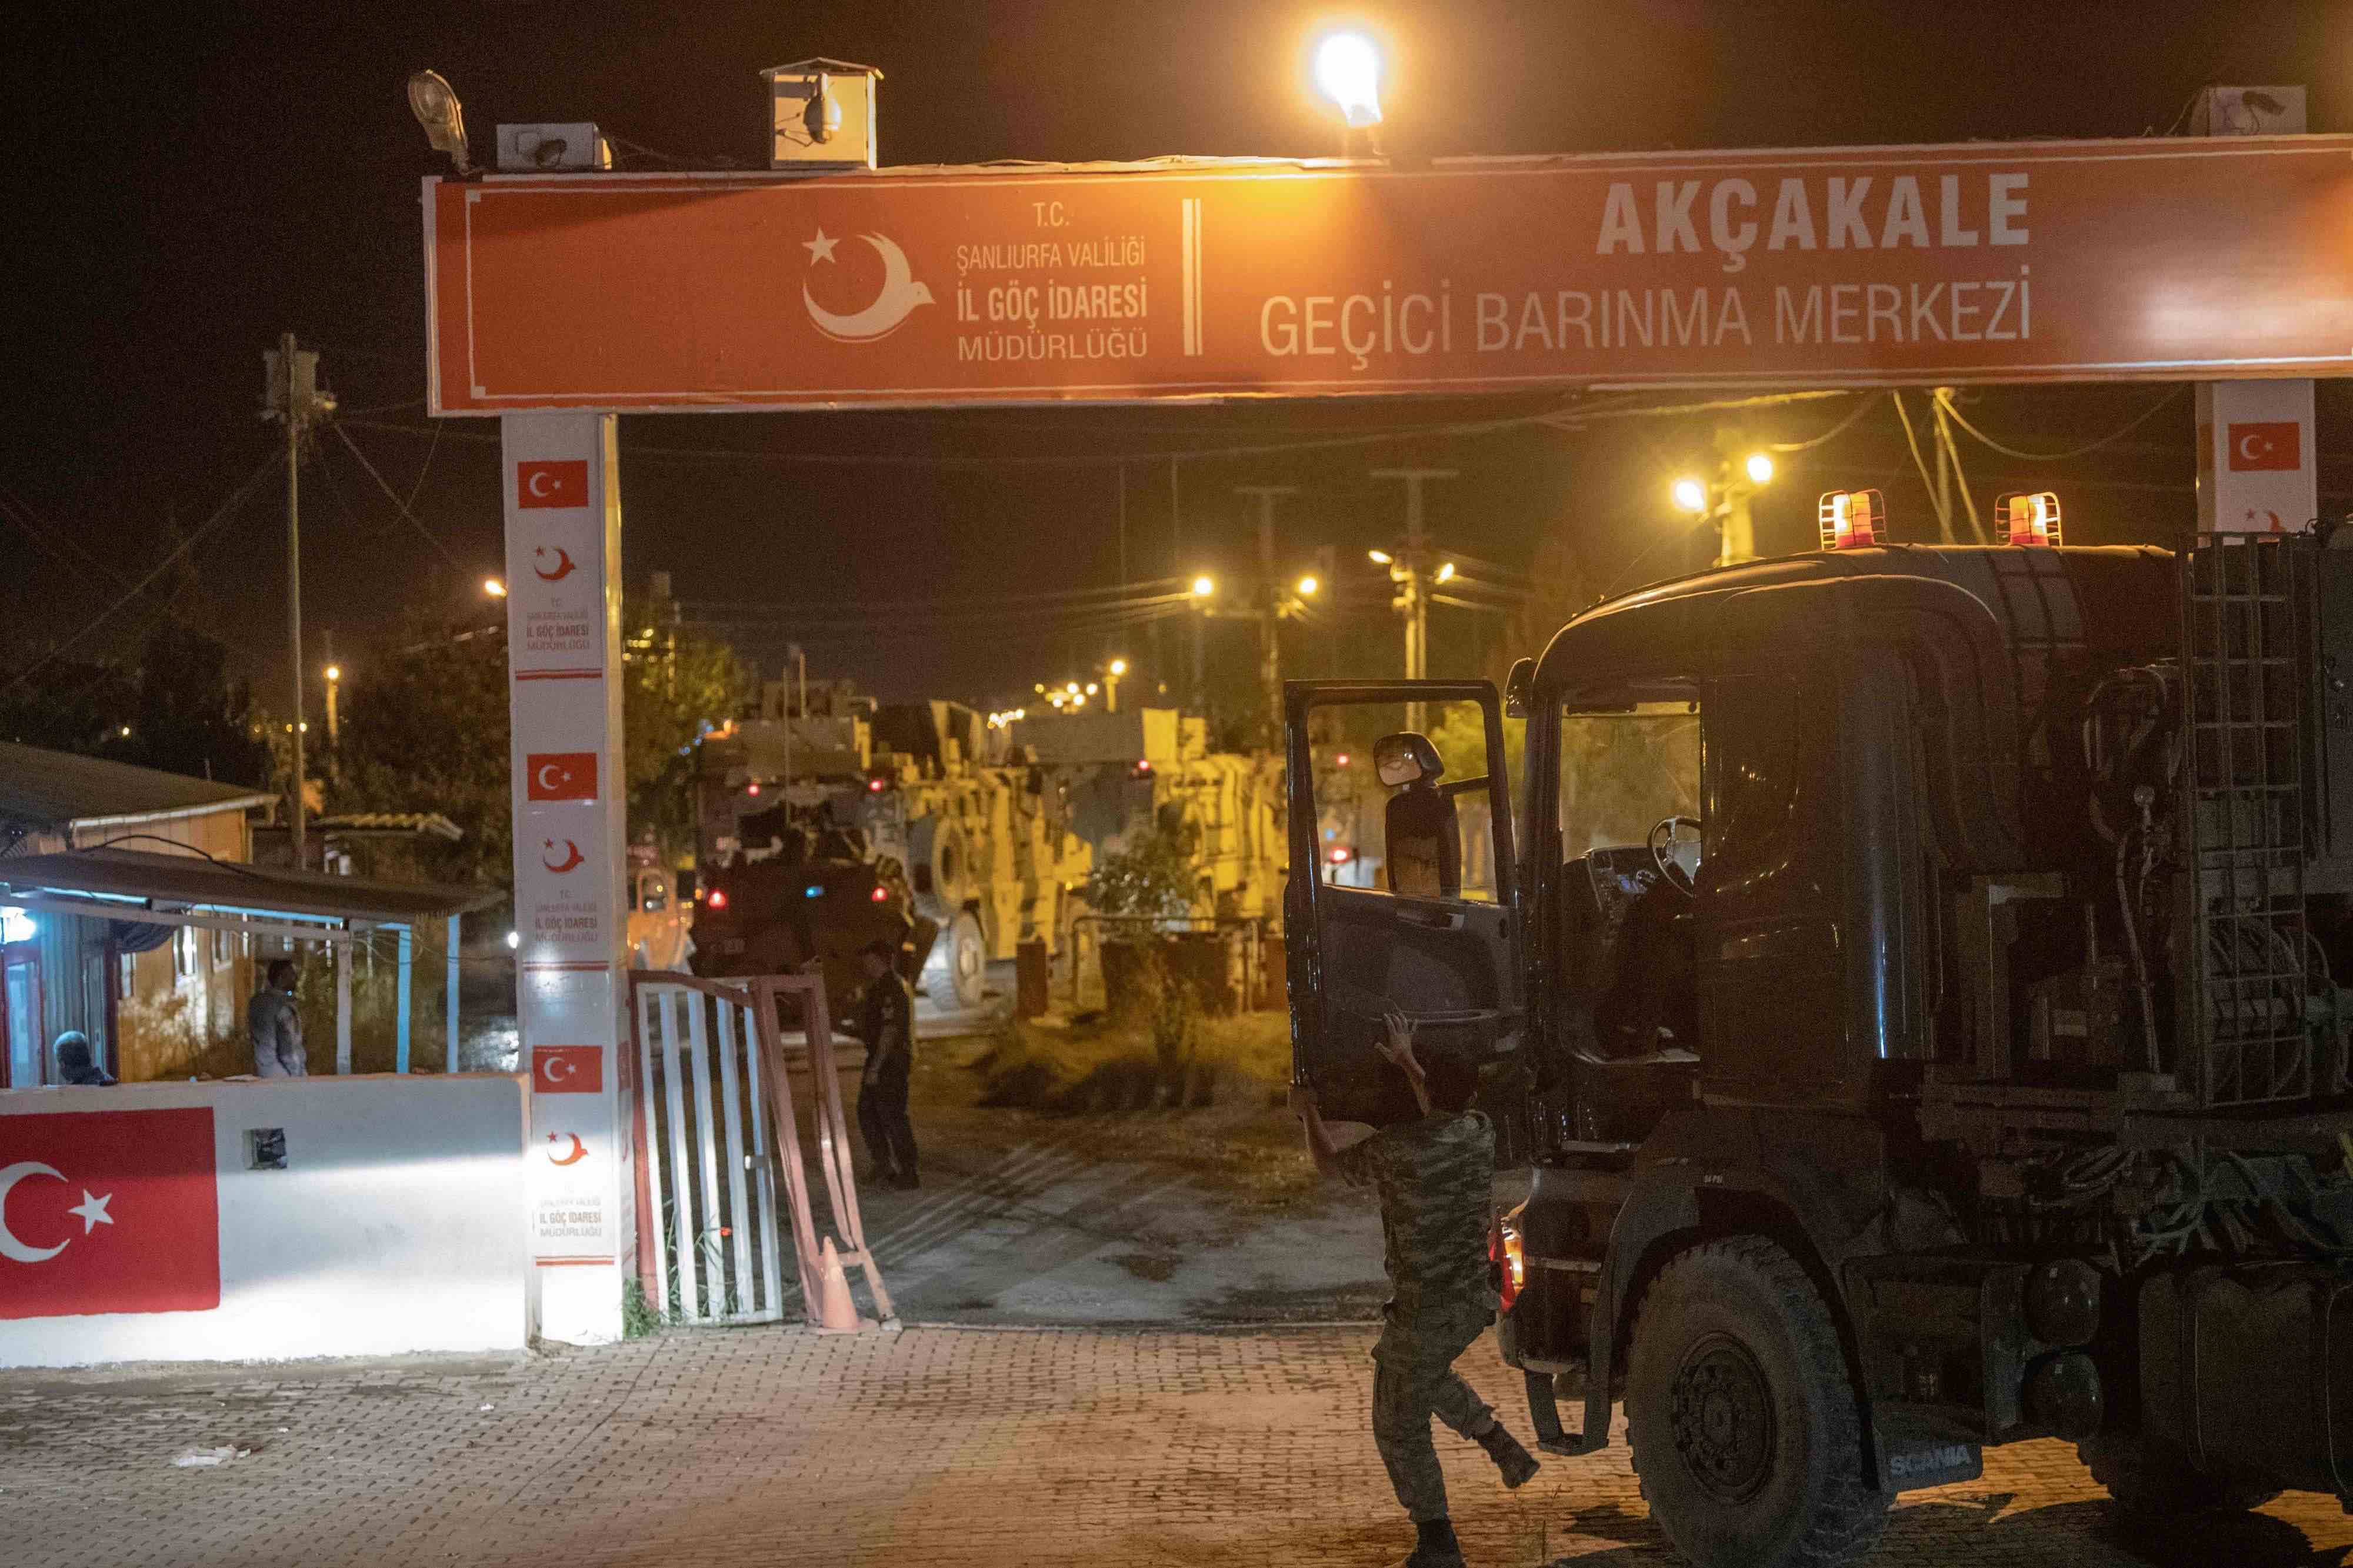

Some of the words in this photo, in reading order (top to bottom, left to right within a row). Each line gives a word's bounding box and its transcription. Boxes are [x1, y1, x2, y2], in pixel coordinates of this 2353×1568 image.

[1032, 201, 1070, 226] T.C.
[1596, 172, 2029, 273] AKÇAKALE
[956, 243, 1062, 276] ŞANLIURFA
[1068, 235, 1145, 267] VALİLİĞİ
[957, 281, 979, 321] İL
[988, 279, 1037, 329] GÖÇ
[1048, 276, 1148, 319] İDARESİ
[1260, 278, 1451, 371] GEÇİCİ
[1477, 286, 1753, 352] BARINMA
[1775, 265, 2030, 343] MERKEZİ
[958, 327, 1148, 361] MÜDÜRLÜĞÜ
